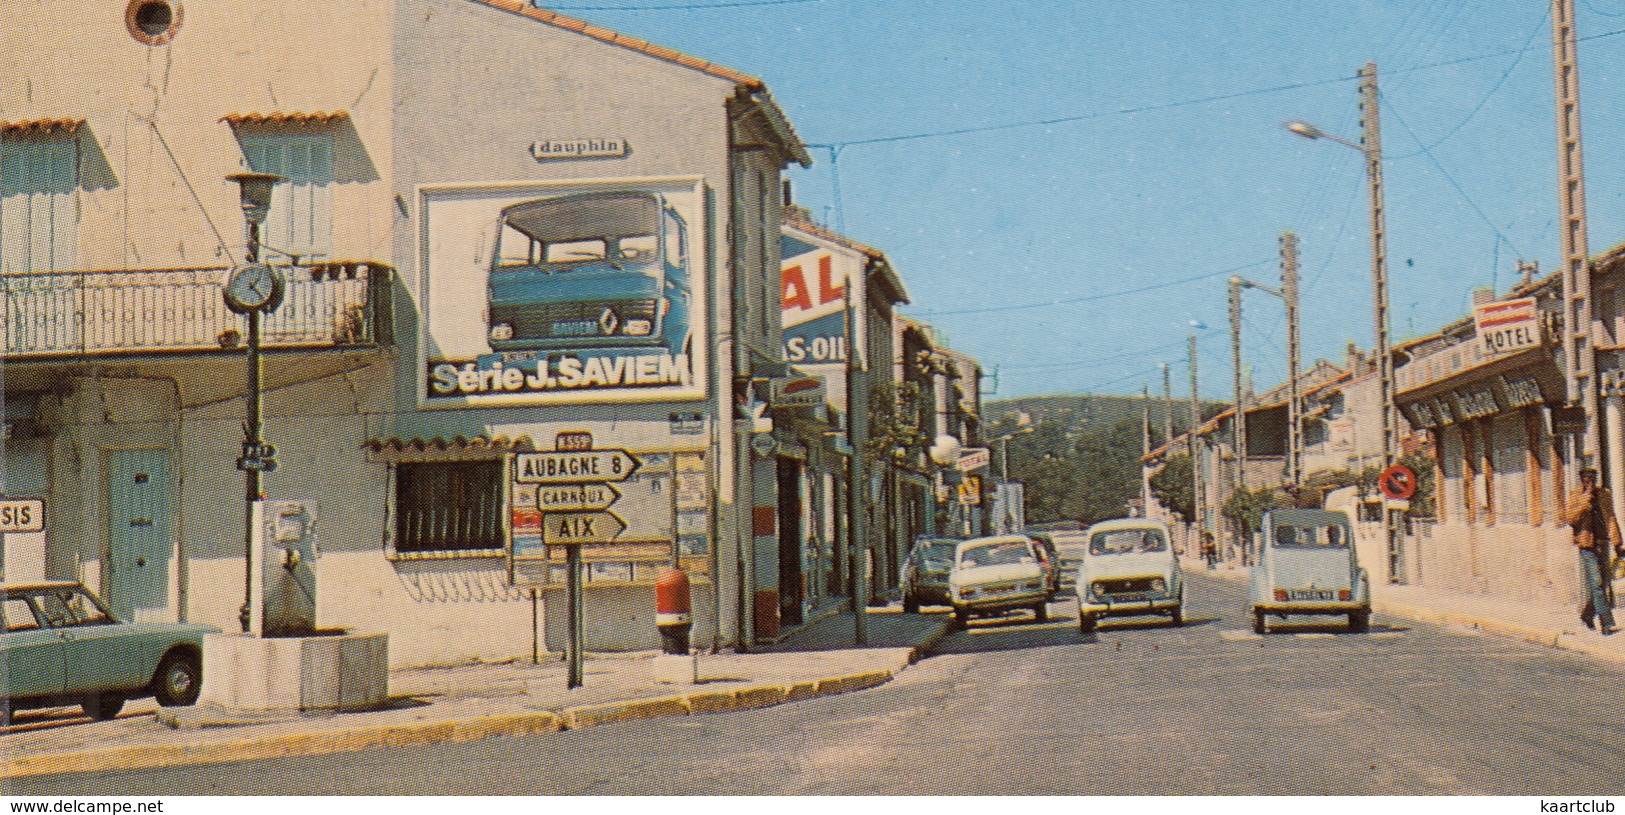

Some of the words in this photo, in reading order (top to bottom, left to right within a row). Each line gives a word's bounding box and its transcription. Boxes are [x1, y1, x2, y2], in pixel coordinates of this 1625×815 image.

[539, 139, 619, 156] dauphin
[1484, 326, 1534, 352] HOTEL
[431, 360, 524, 395] Série
[523, 456, 600, 477] AUBAGNE
[611, 455, 622, 475] 8
[542, 489, 605, 504] CARNOUX
[558, 516, 595, 538] AIX
